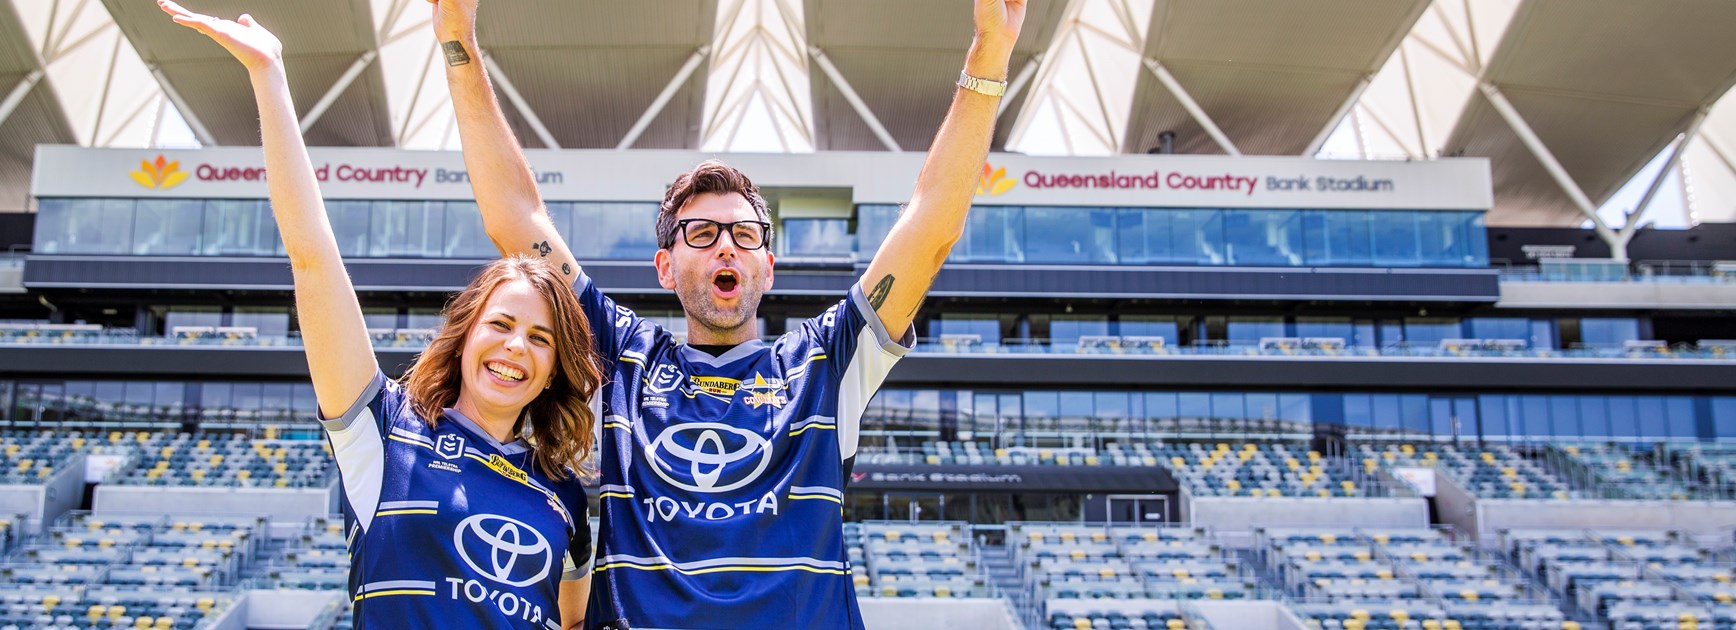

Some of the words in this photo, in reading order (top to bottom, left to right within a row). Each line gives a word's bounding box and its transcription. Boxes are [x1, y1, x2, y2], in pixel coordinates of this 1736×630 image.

[196, 163, 329, 181] Queend
[336, 164, 427, 188] Country
[435, 168, 470, 183] Ban
[1024, 170, 1158, 189] Queensland
[1166, 172, 1257, 196] Country
[1266, 175, 1312, 191] Bank
[1316, 175, 1394, 192] Stadium
[643, 490, 778, 522] TOYOTA
